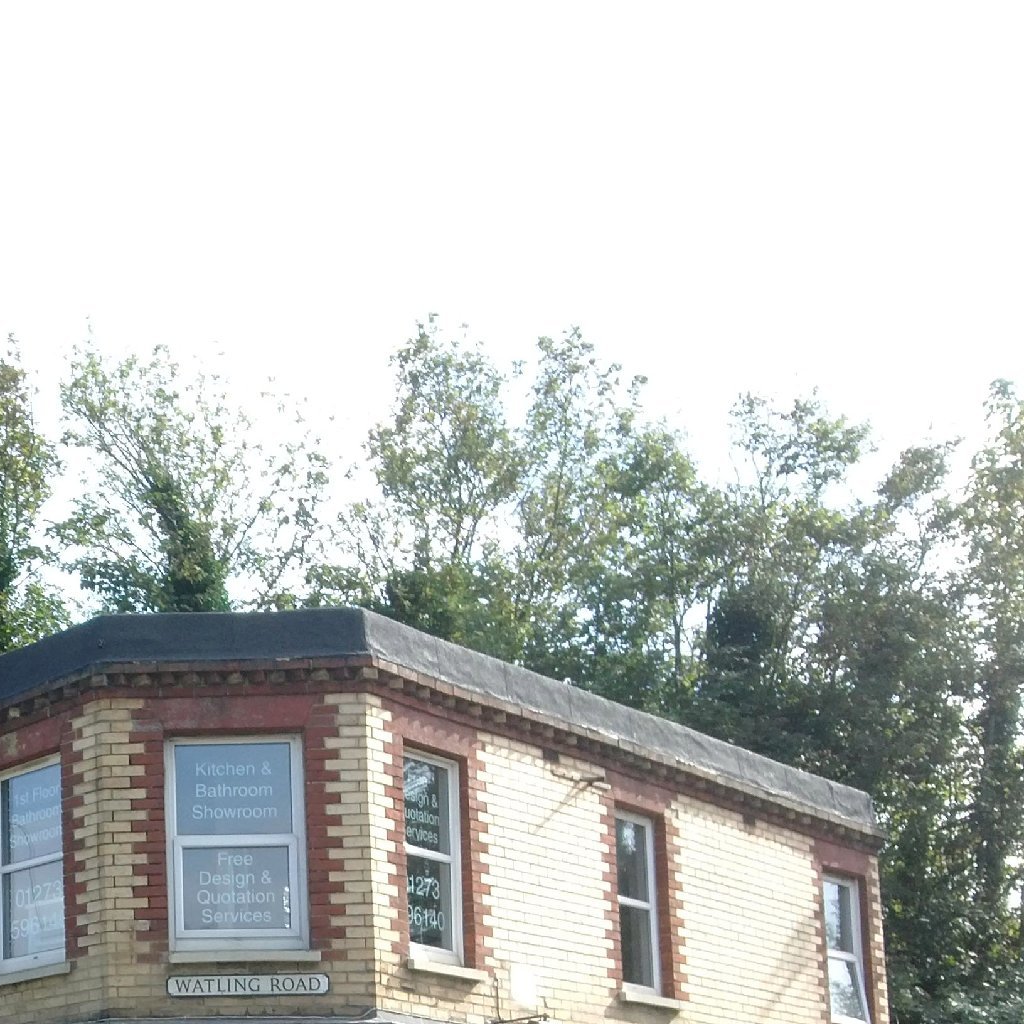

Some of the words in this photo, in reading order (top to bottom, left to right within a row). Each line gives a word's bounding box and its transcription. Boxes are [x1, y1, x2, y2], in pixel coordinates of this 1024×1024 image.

[195, 762, 256, 777] Kitchen
[261, 761, 272, 776] &
[195, 783, 273, 798] Bathroom
[405, 790, 429, 808] esign
[431, 793, 438, 808] &
[192, 805, 278, 820] Showroom
[405, 807, 439, 826] uotation
[406, 826, 438, 844] ervices
[217, 852, 254, 866] Free
[199, 870, 255, 889] Design
[261, 870, 272, 884] &
[407, 874, 440, 899] 1273
[16, 880, 63, 907] 01273
[196, 889, 276, 905] Quotation
[201, 908, 273, 923] Services
[407, 904, 445, 931] 96140
[175, 977, 261, 994] WATLING
[270, 976, 322, 992] ROAD
